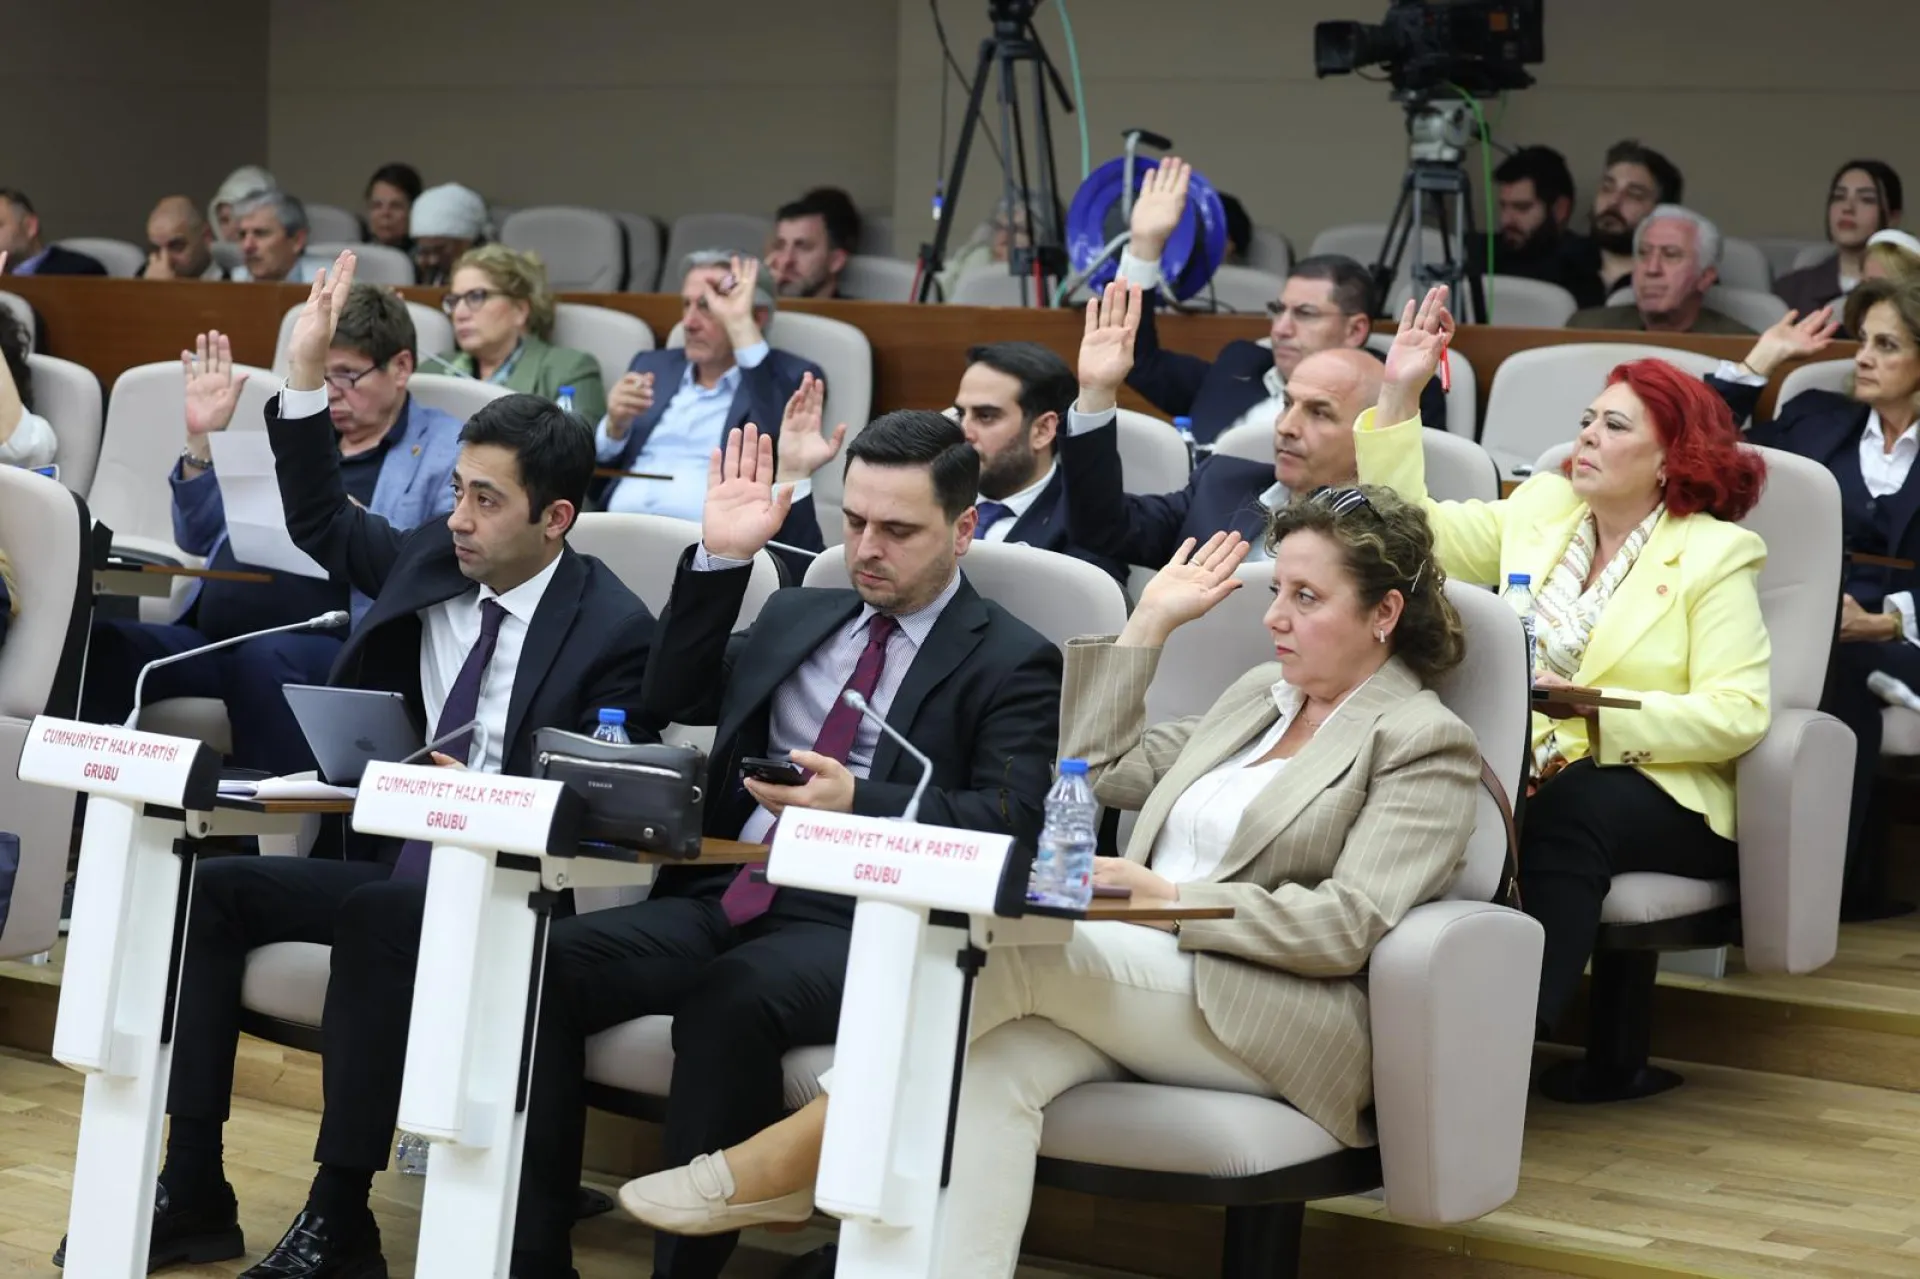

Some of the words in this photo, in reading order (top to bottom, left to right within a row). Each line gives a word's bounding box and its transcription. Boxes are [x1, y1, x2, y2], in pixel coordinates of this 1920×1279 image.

[42, 729, 107, 753] CUMHURİYET
[108, 738, 139, 755] HALK
[138, 743, 180, 762] PARTİSİ
[83, 762, 120, 781] GRUBU
[377, 775, 453, 799] CUMHURİYET
[455, 784, 487, 802] HALK
[426, 811, 468, 830] GRUBU
[794, 823, 883, 848] CUMHURİYET
[886, 835, 923, 854] HALK
[854, 864, 902, 884] GRUBU
